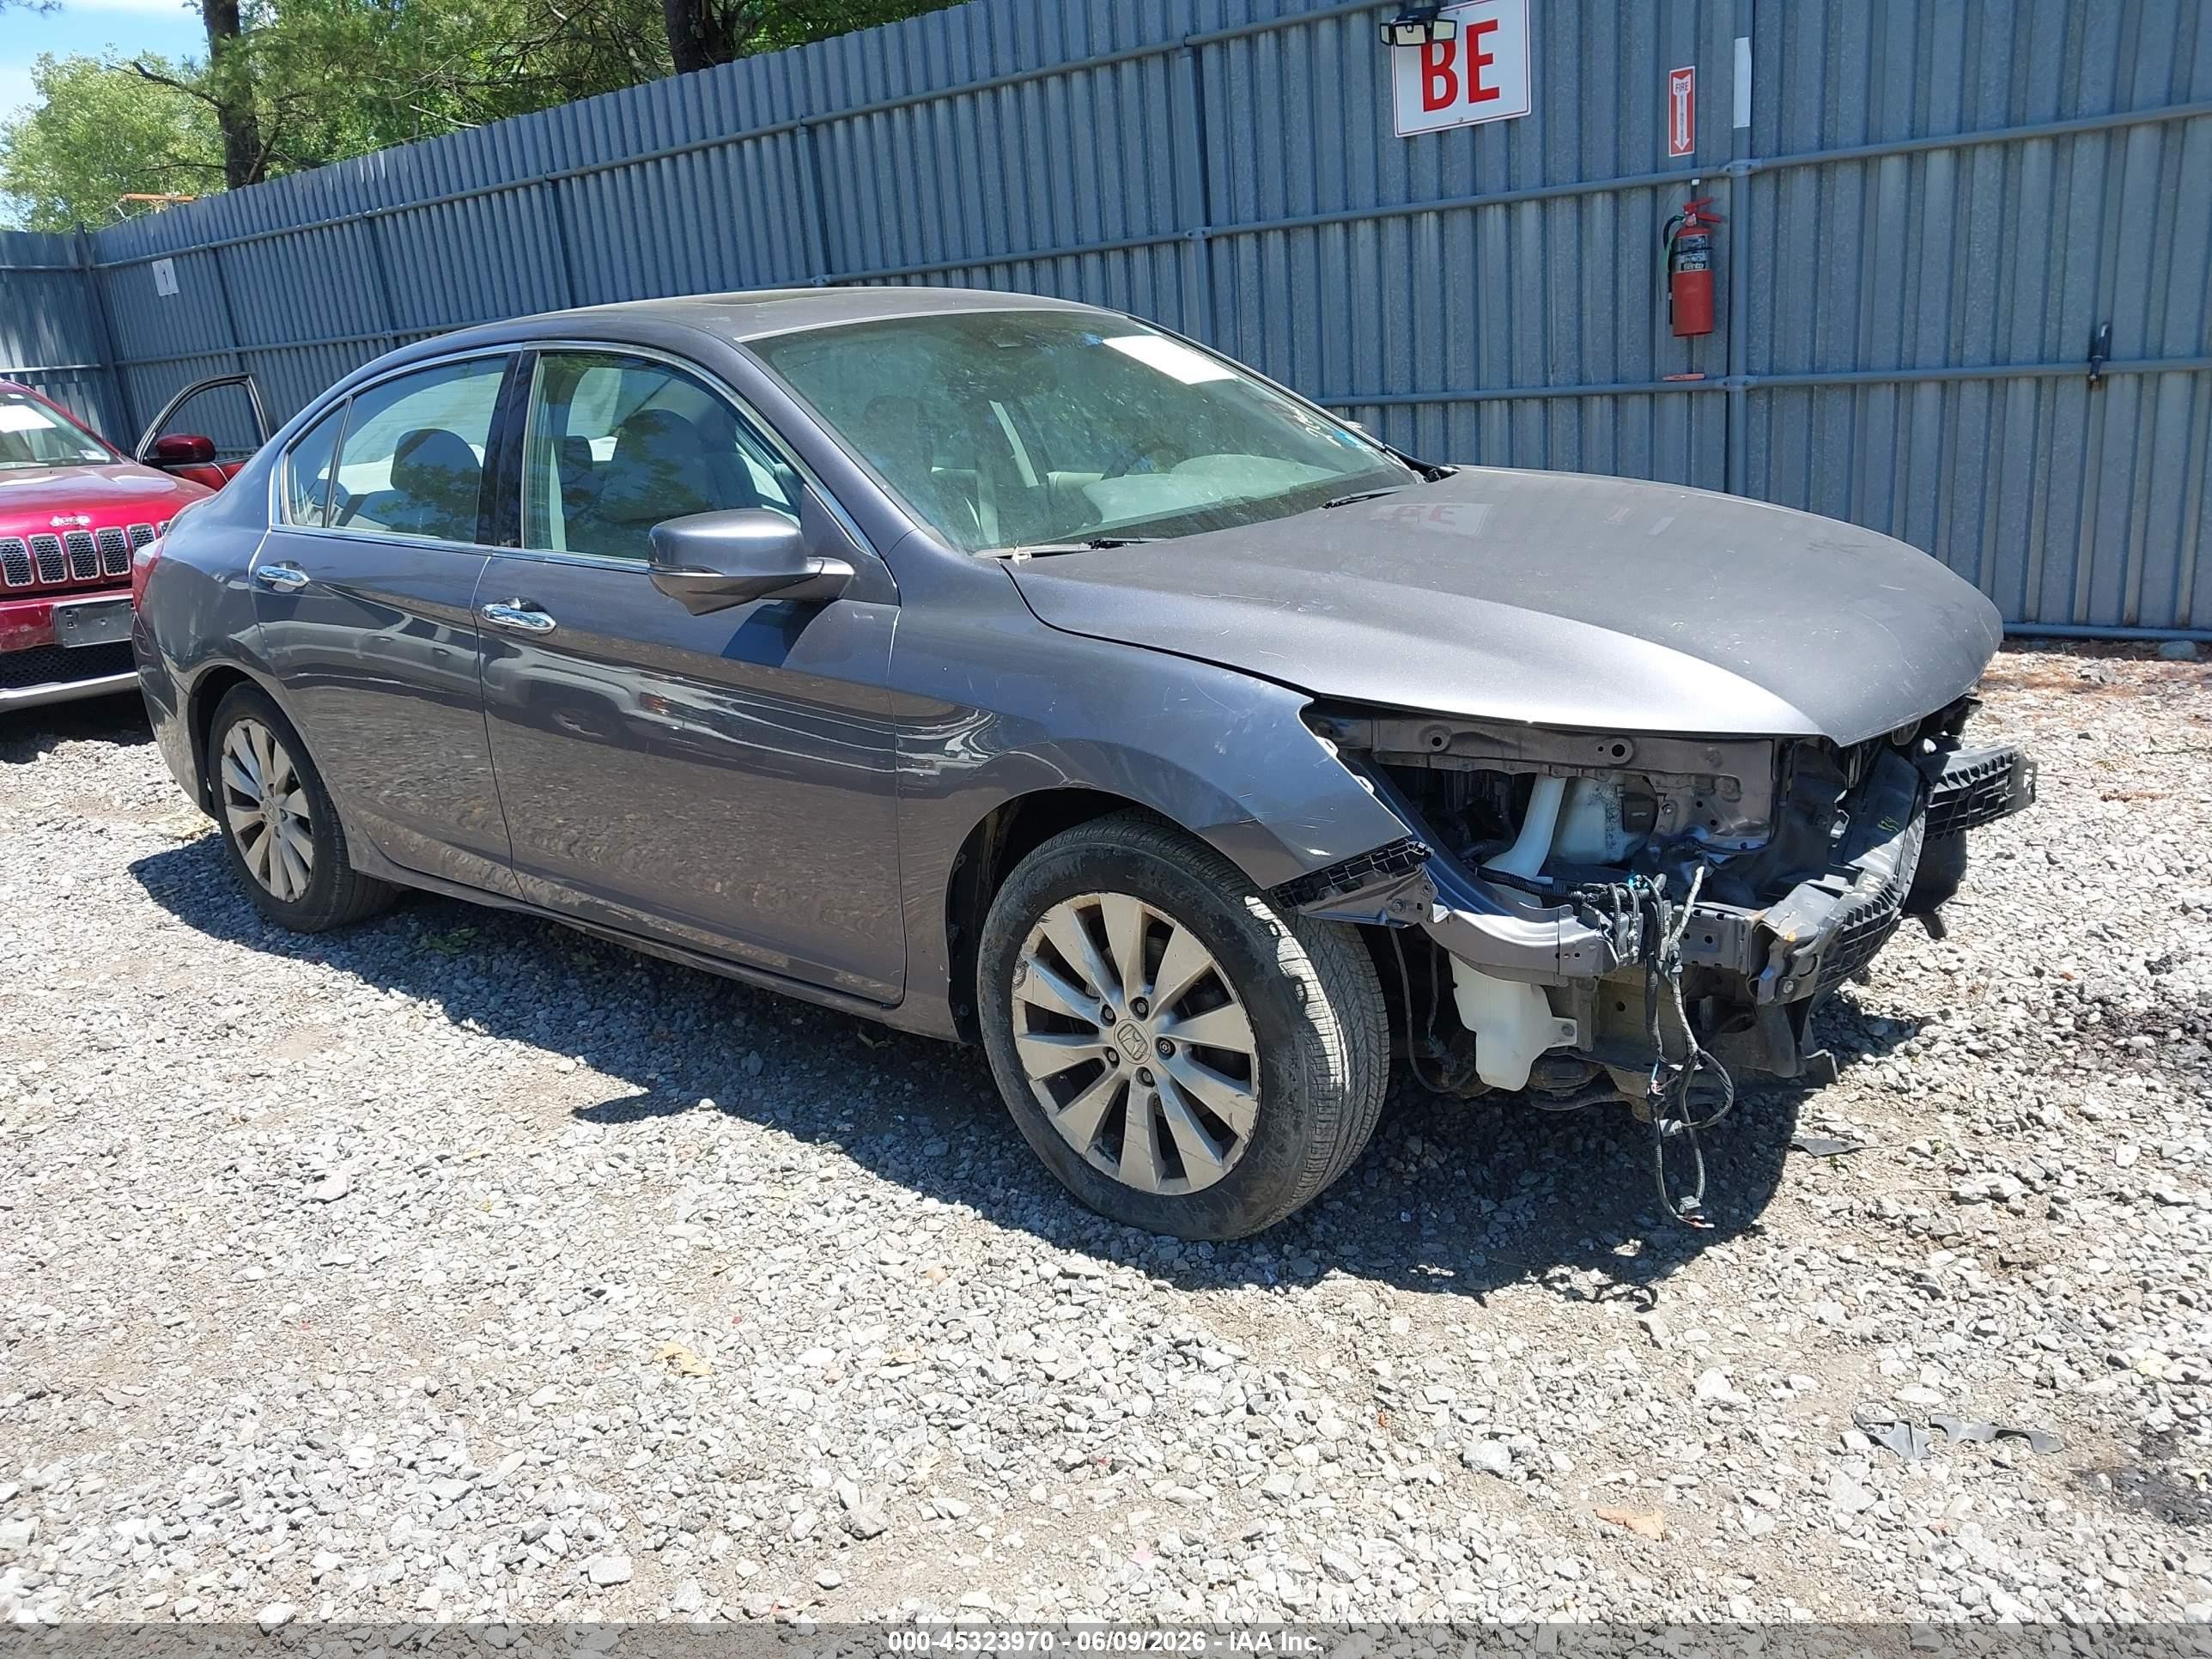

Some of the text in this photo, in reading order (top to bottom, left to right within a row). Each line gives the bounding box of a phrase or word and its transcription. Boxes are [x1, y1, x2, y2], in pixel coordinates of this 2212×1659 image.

[1420, 19, 1500, 112] BE
[1675, 81, 1689, 92] FIRE
[162, 269, 169, 286] 1
